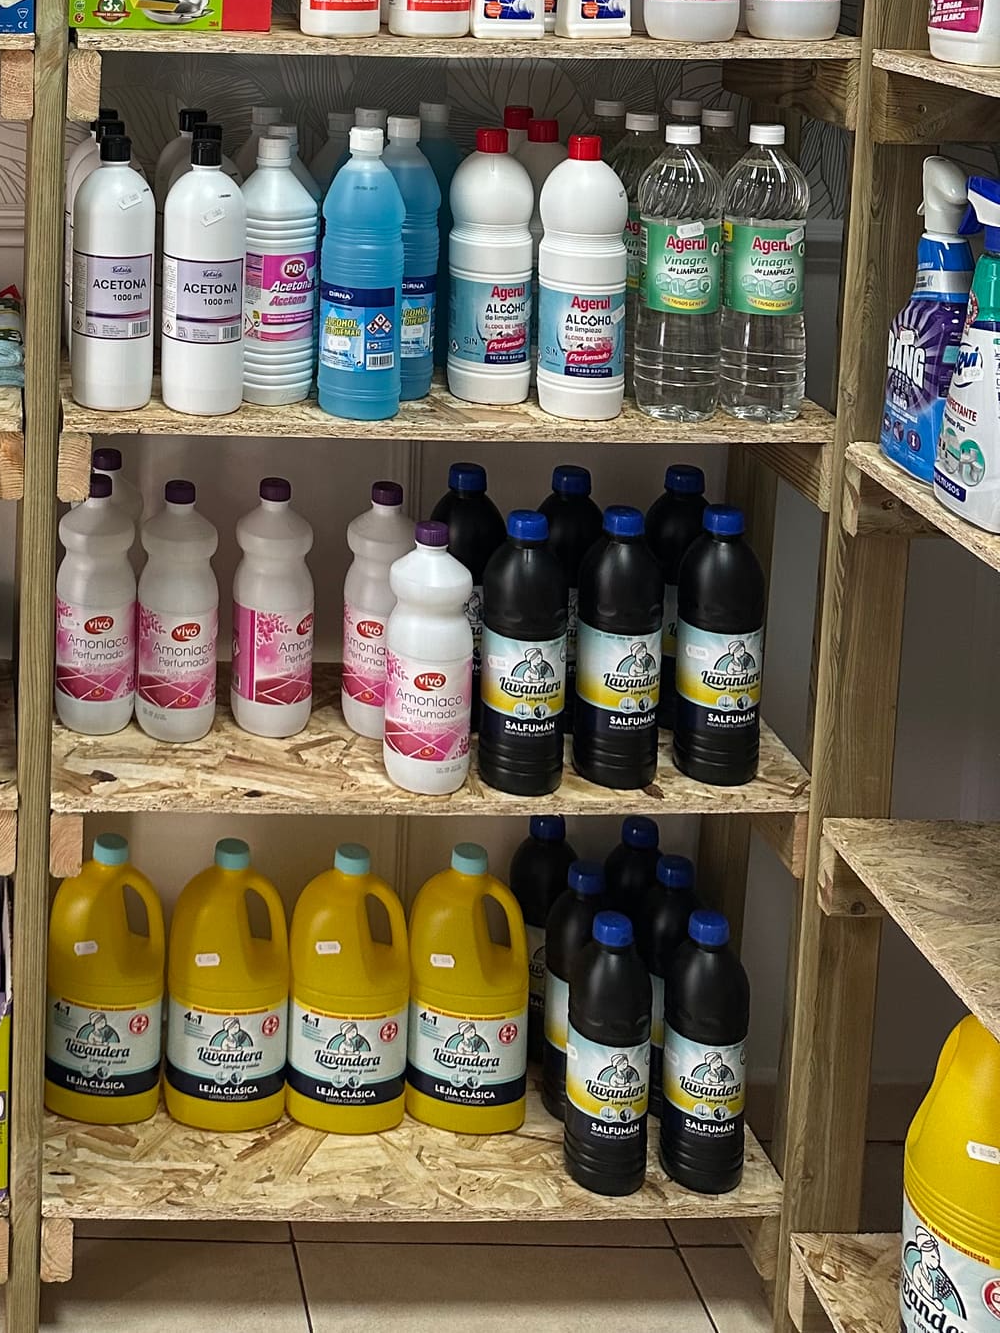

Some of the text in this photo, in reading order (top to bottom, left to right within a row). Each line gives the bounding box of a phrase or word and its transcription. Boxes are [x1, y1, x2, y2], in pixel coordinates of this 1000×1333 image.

[666, 235, 707, 254] Agerul
[664, 255, 707, 267] Vinagre
[751, 256, 793, 268] Vinagre
[287, 263, 303, 273] PQS
[677, 267, 708, 275] LIMPIEZA
[764, 268, 794, 276] LIMPIEZA
[93, 279, 146, 290] ACETONA
[184, 283, 238, 294] ACETONA
[204, 298, 221, 306] 1000
[571, 296, 610, 312] Agerul
[569, 352, 610, 362] Perfumado
[68, 634, 129, 649] Amoniaco
[73, 649, 123, 660] Perfumado
[153, 642, 213, 657] Amoniaco
[159, 656, 209, 667] Perfumado
[500, 676, 560, 697] Lavandera
[396, 687, 462, 705] Amoniaco
[401, 704, 457, 718] Perfumado
[610, 713, 655, 725] SALFUMÁN
[708, 712, 755, 723] SALFUMÁN
[505, 720, 554, 732] SALFUMÁN
[64, 1037, 129, 1058] Lavandera
[197, 1045, 263, 1065] Lavandera
[433, 1048, 499, 1067] Lavandera
[66, 1075, 124, 1090] LEJÍA CLÁSICA
[199, 1083, 258, 1094] LEJÍA CLÁSICA
[435, 1084, 496, 1099] LEJÍA CLÁSICA
[592, 1122, 639, 1134] SALFUMÁN
[686, 1119, 735, 1133] SALFUMÁN
